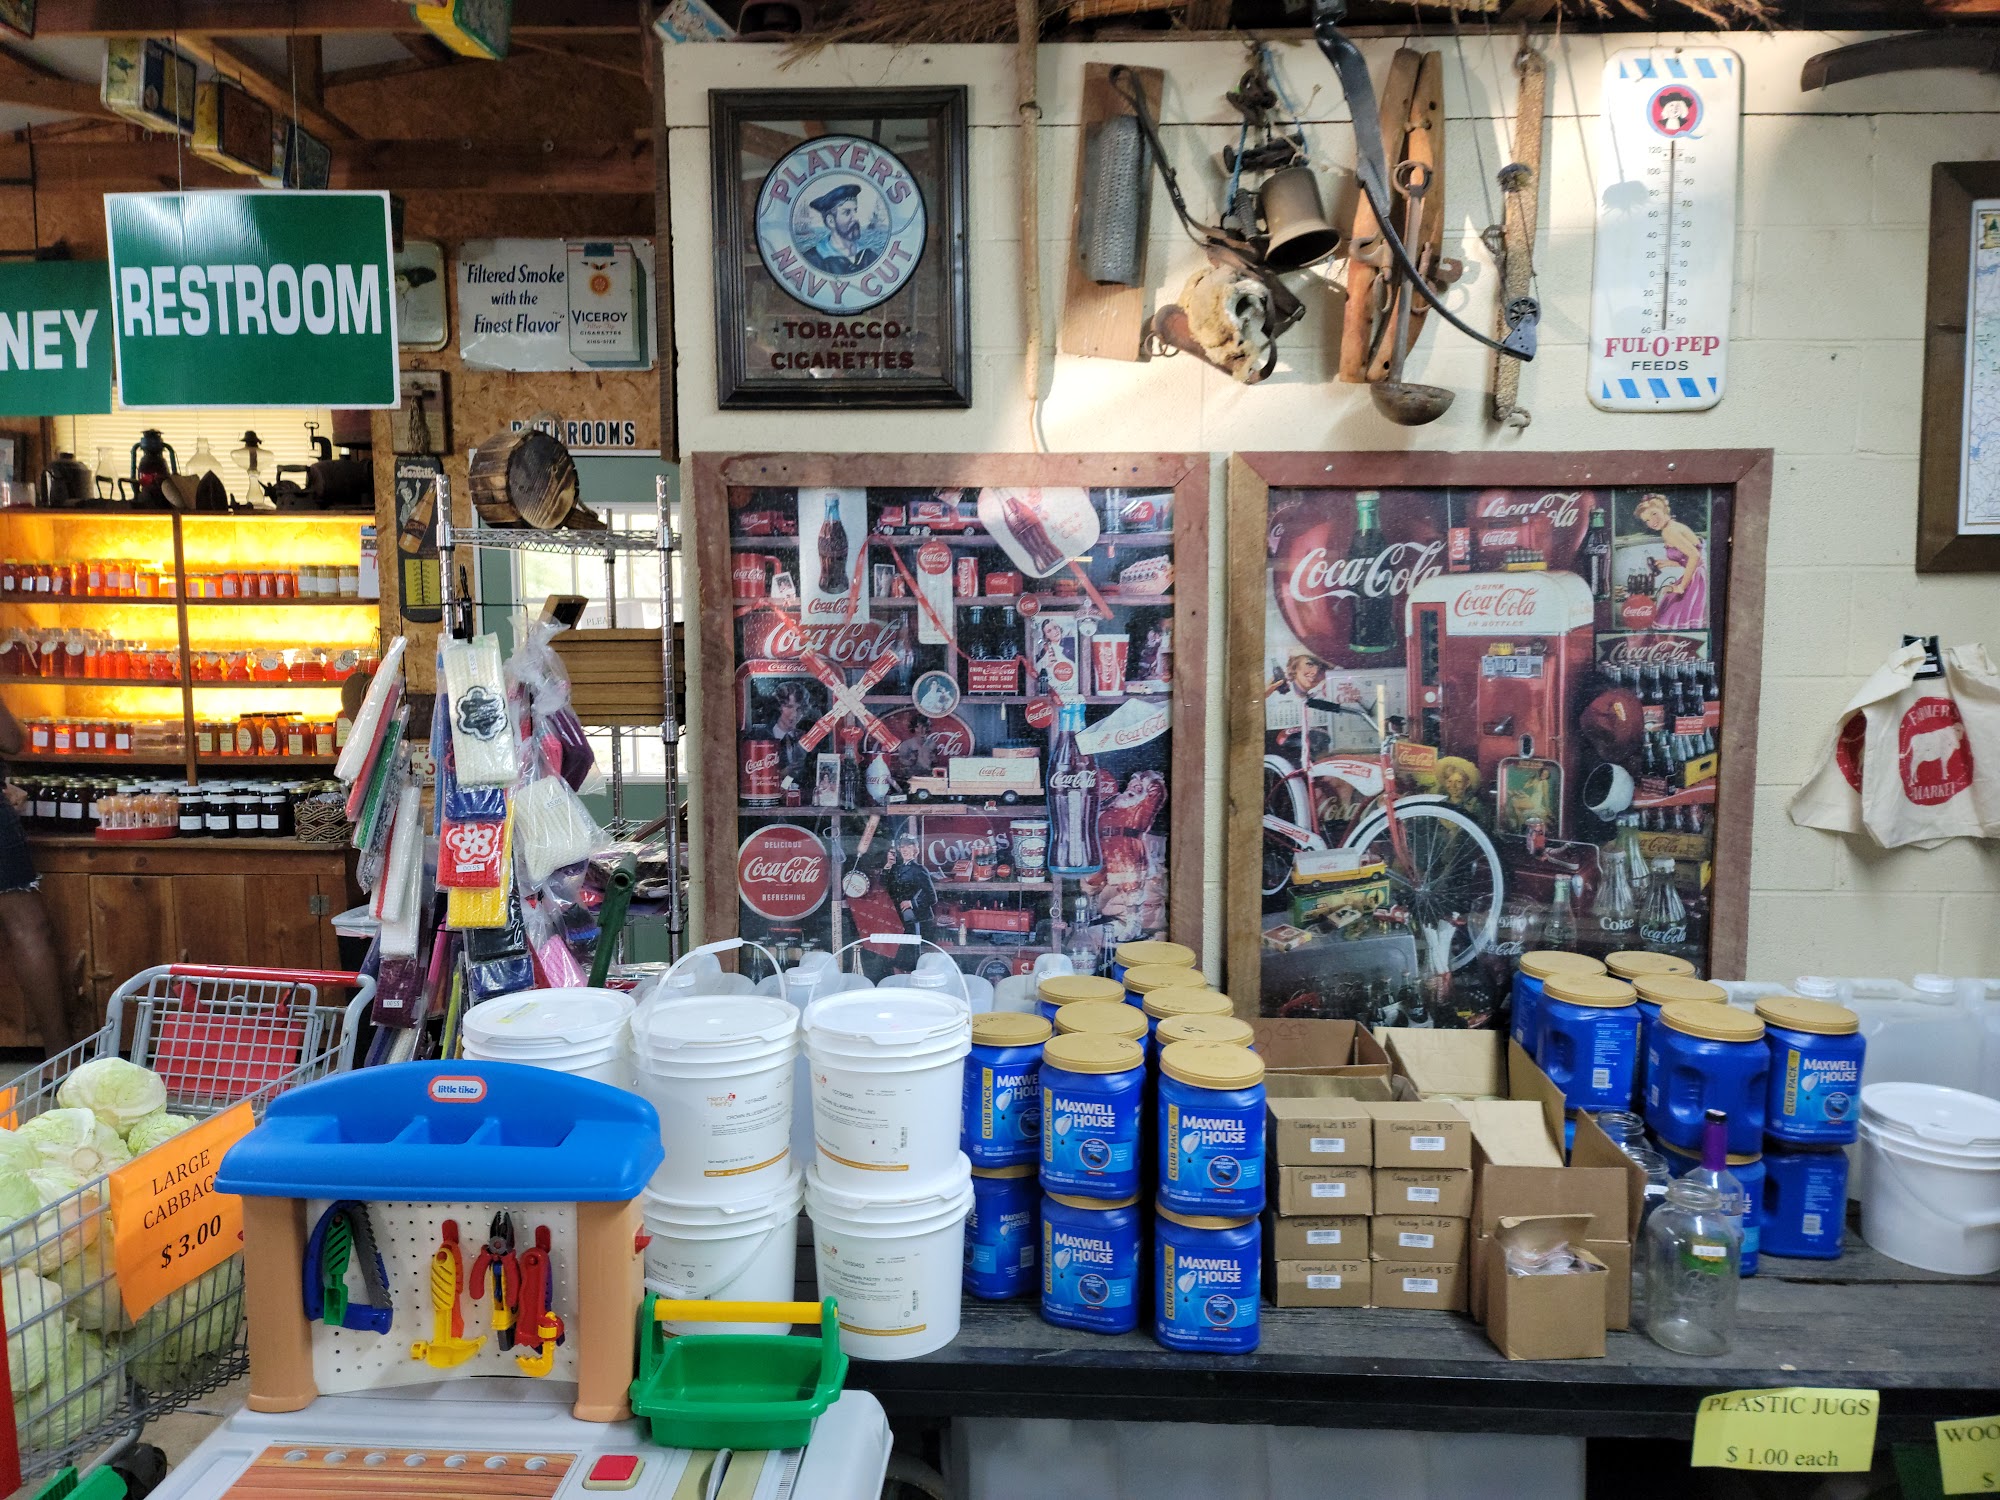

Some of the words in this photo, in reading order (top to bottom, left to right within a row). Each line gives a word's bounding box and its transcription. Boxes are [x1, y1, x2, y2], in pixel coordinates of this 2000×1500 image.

[1684, 156, 1696, 164] 110
[769, 142, 913, 204] PLAYER'S
[1647, 168, 1661, 176] 100
[1684, 178, 1694, 186] 90
[1648, 189, 1660, 197] 80
[1681, 200, 1693, 208] 70
[1681, 220, 1692, 228] 50
[1646, 231, 1658, 239] 40
[1680, 240, 1691, 248] 30
[1646, 251, 1657, 259] 20
[771, 245, 850, 304] NAVY
[860, 240, 914, 297] CUT
[1679, 260, 1688, 268] 10
[518, 263, 565, 284] Smoke
[1649, 270, 1655, 278] 0
[1678, 279, 1687, 287] 10
[120, 263, 382, 337] RESTROOM
[491, 290, 516, 305] with
[519, 290, 538, 305] the
[1643, 289, 1654, 297] 20
[1677, 298, 1687, 306] 30
[571, 310, 628, 325] VICEROY
[1641, 308, 1652, 316] 40
[474, 314, 514, 334] Finest
[783, 321, 901, 339] TOBACCO
[1640, 326, 1652, 334] 60
[771, 352, 914, 370] CIGARETTES
[1631, 361, 1689, 371] FEEDS
[1288, 540, 1447, 602] Coca-Cola
[1474, 583, 1506, 591] DRINK
[1453, 587, 1540, 617] Coca-Cola
[1622, 606, 1653, 617] Coca-Cola
[1609, 640, 1691, 664] Coca-Cola
[1114, 716, 1167, 745] Coca-Cola
[745, 752, 780, 774] Coca-Cola
[1399, 750, 1434, 767] Coca-Cola
[1050, 770, 1096, 789] Coca-Cola
[1912, 782, 1957, 801] MARKET
[764, 841, 802, 849] DELICIOUS
[744, 856, 824, 884] Coca-Cola
[762, 893, 806, 901] REFRESHING
[1600, 916, 1635, 931] Coke
[1640, 924, 1688, 944] Coca-Cola
[1803, 1058, 1857, 1071] MAXWELL
[996, 1074, 1039, 1088] MAXWE
[1820, 1071, 1857, 1083] HOUSE
[438, 1085, 457, 1093] little
[458, 1085, 478, 1093] tikes
[983, 1084, 992, 1109] PACK
[1055, 1098, 1116, 1116] MAXWELL
[983, 1111, 992, 1138] CLUB
[1073, 1115, 1116, 1128] HOUSE
[1182, 1115, 1246, 1132] MAXWELL
[1168, 1124, 1177, 1151] PACK
[1202, 1130, 1246, 1144] HOUSE
[152, 1149, 211, 1196] LARGE
[1168, 1153, 1177, 1180] CLUB
[143, 1171, 219, 1230] CABBAG
[161, 1243, 172, 1269] $
[178, 1214, 222, 1258] 3.00
[1055, 1231, 1114, 1252] MAXWELL
[1072, 1248, 1114, 1264] HOUSE
[1178, 1255, 1241, 1271] MAXWELL
[1165, 1262, 1175, 1289] PACK
[1198, 1270, 1241, 1283] HOUSE
[1165, 1290, 1175, 1318] CLUB
[1707, 1396, 1805, 1415] PLASTIC
[1811, 1398, 1871, 1416] JUGS
[1726, 1445, 1738, 1463] $
[1747, 1447, 1789, 1466] 1.00
[1795, 1450, 1840, 1467] each
